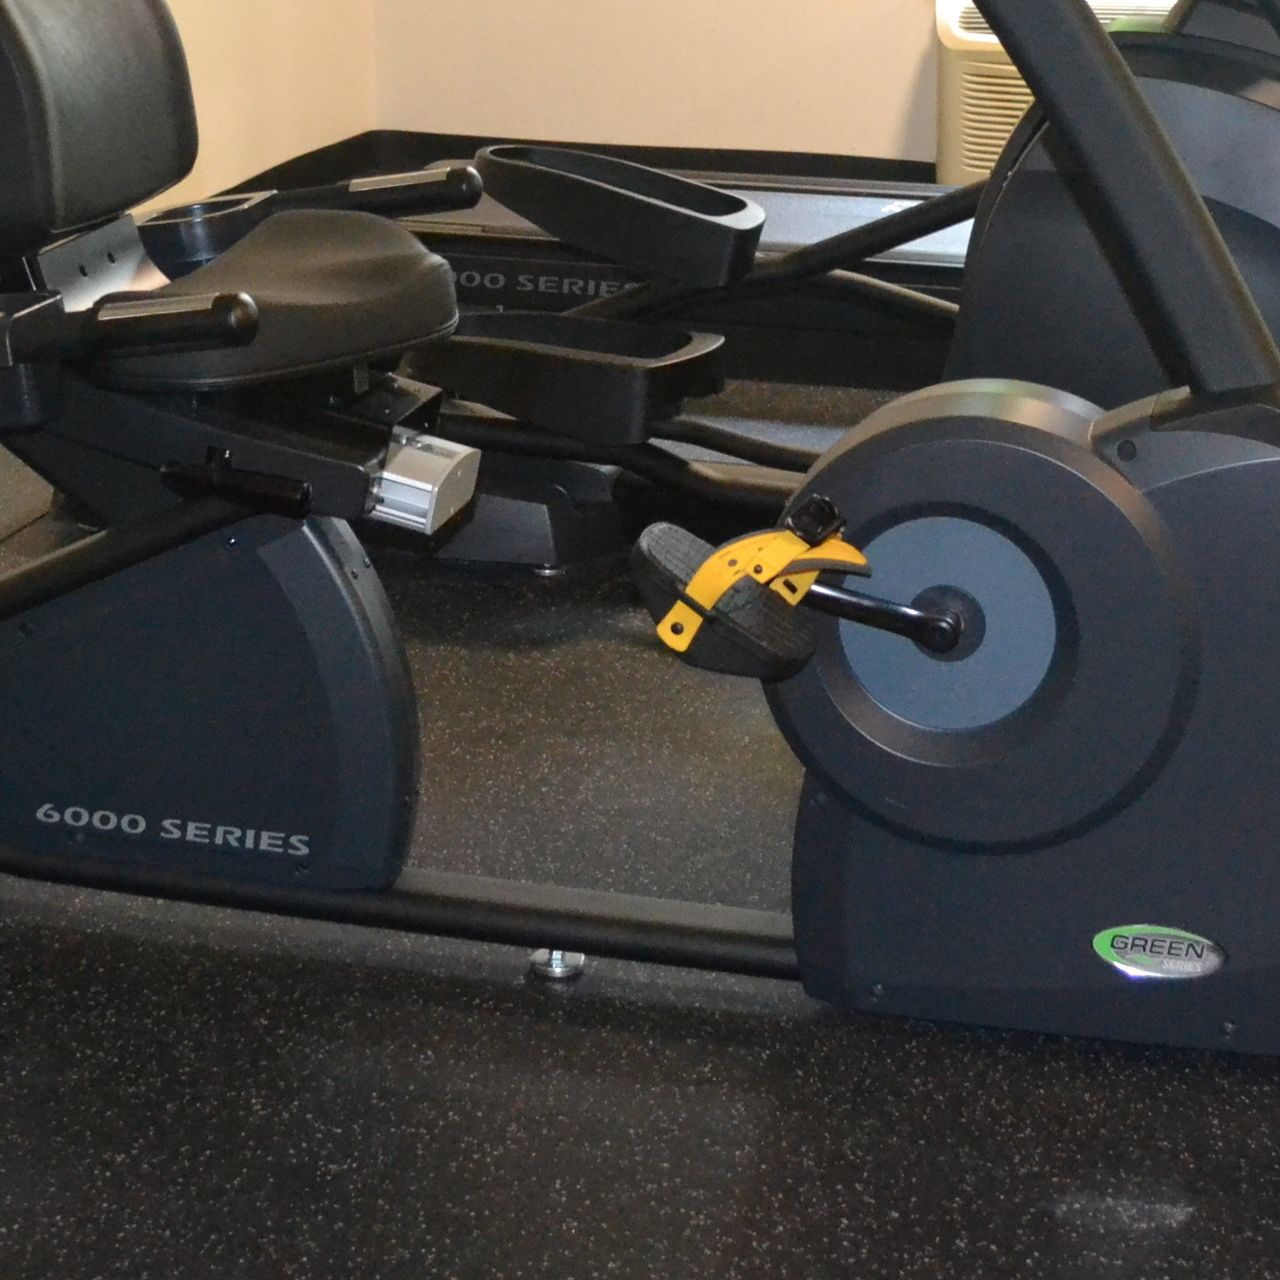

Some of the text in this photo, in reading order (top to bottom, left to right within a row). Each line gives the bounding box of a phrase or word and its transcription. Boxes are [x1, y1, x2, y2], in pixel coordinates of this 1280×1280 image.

[452, 271, 637, 298] 00 SERIE
[36, 802, 310, 857] 6000 SERIES
[1110, 934, 1205, 959] GREEN
